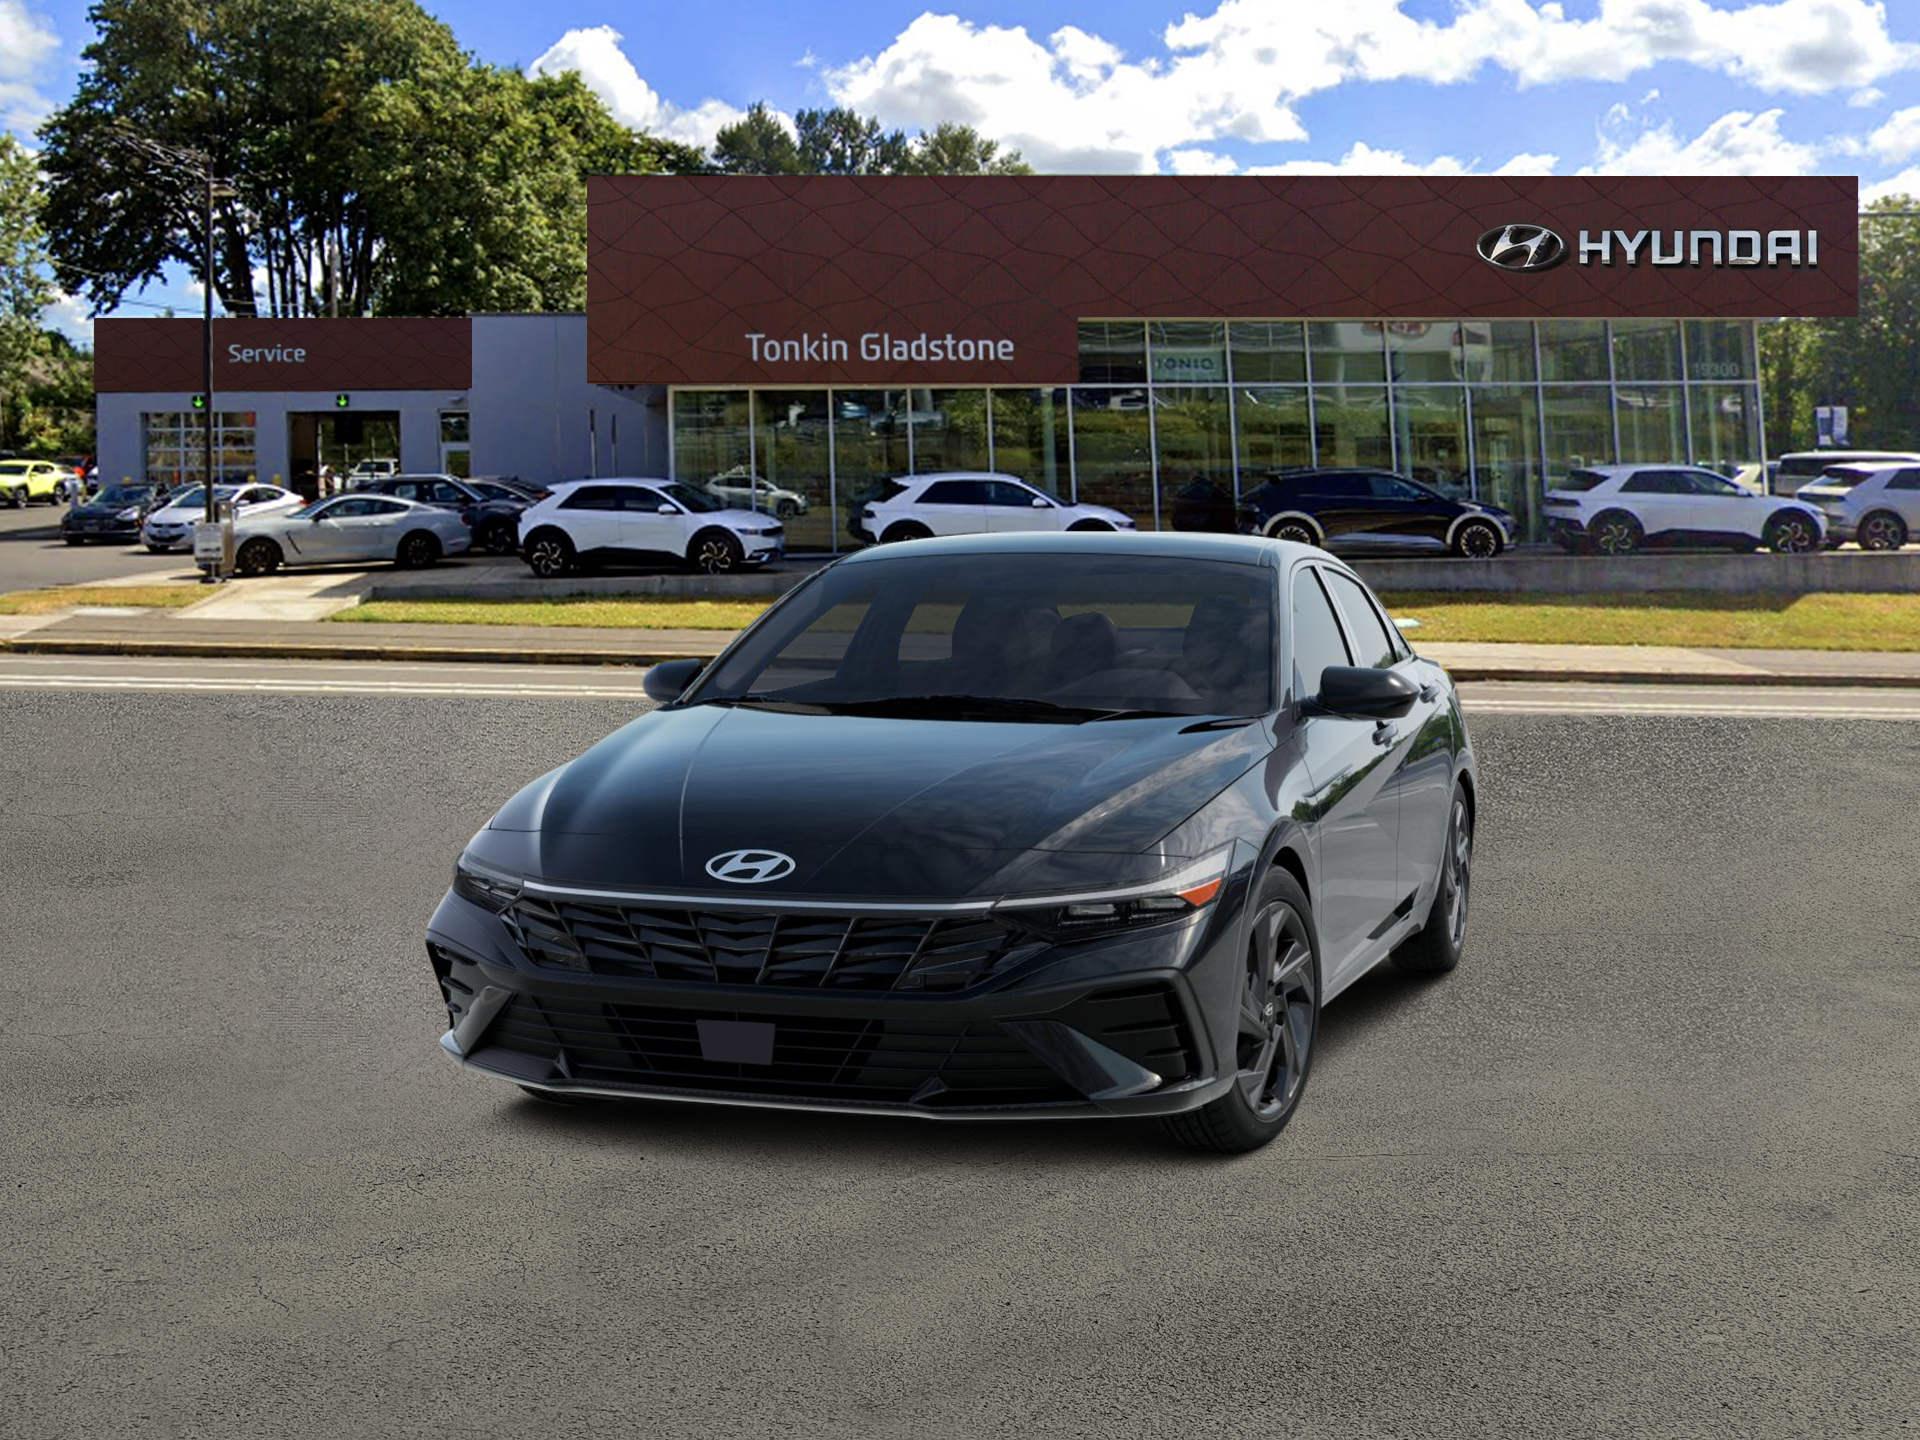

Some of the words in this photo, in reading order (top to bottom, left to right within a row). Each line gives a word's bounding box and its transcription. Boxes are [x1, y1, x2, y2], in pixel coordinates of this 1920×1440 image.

[1579, 229, 1818, 265] HYUNDAI
[228, 343, 307, 363] Service
[745, 333, 848, 362] Tonkin
[860, 333, 1014, 362] Gladstone
